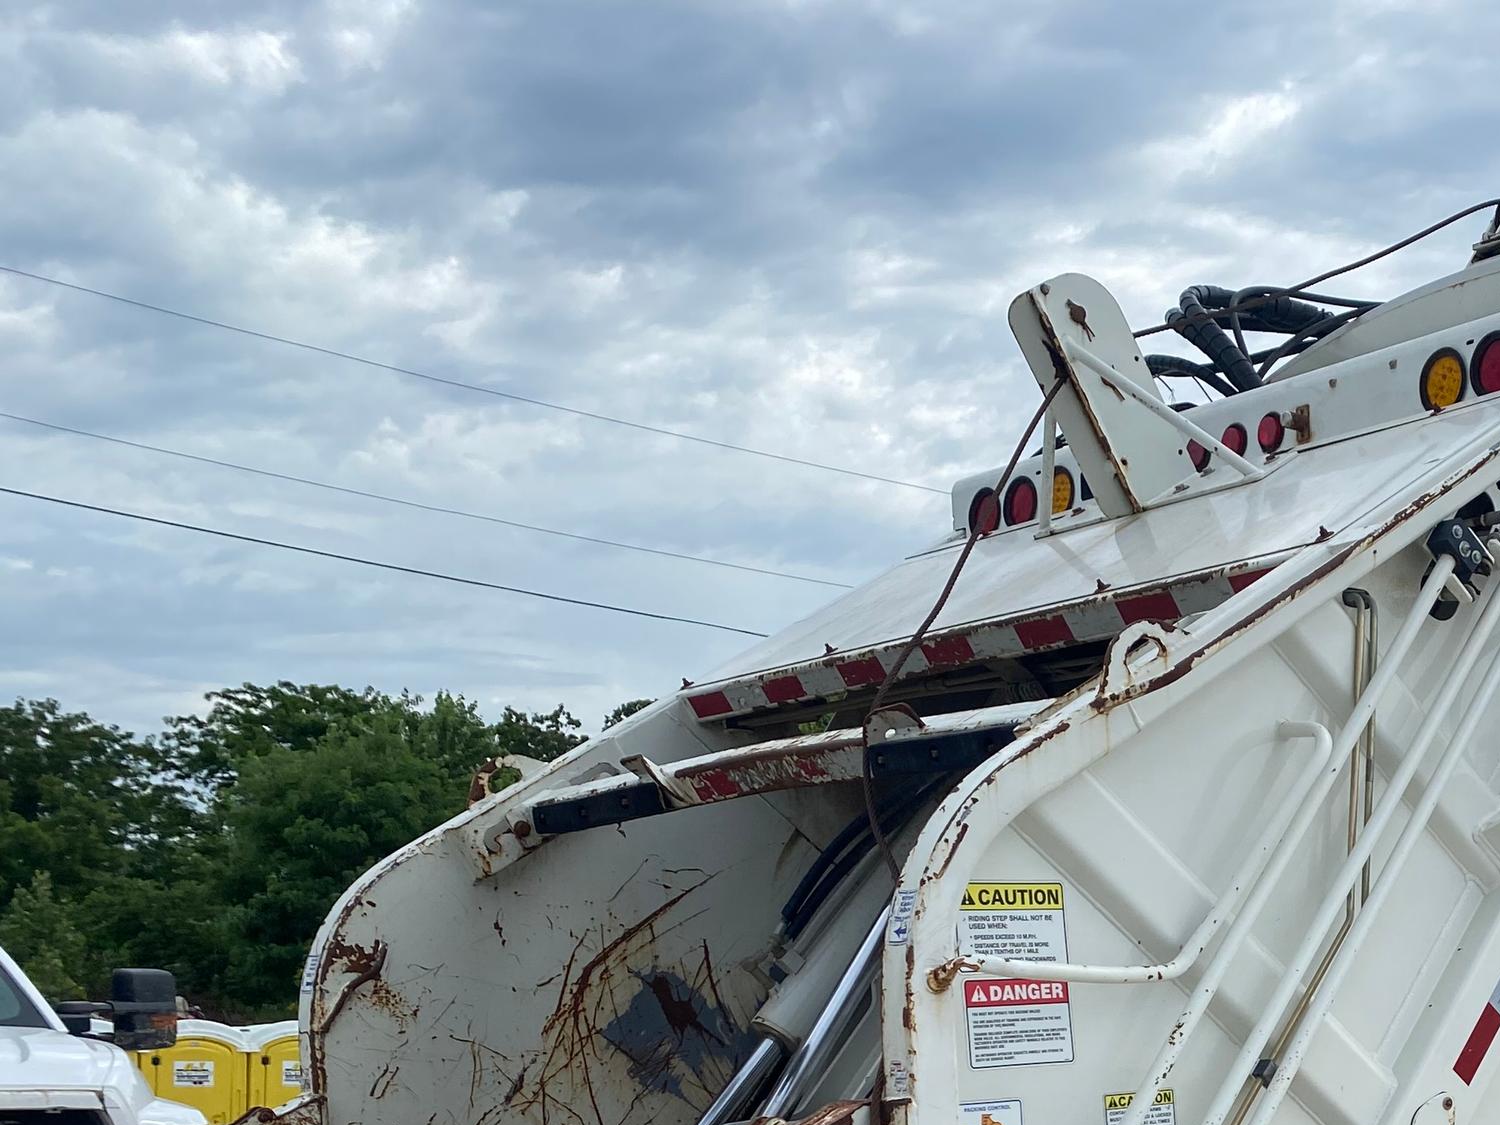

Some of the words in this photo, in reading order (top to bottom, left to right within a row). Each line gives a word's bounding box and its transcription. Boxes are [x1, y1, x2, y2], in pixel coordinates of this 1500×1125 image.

[978, 889, 1059, 905] CAUTION
[989, 983, 1063, 1001] DANGER
[1118, 1092, 1171, 1106] CAON
